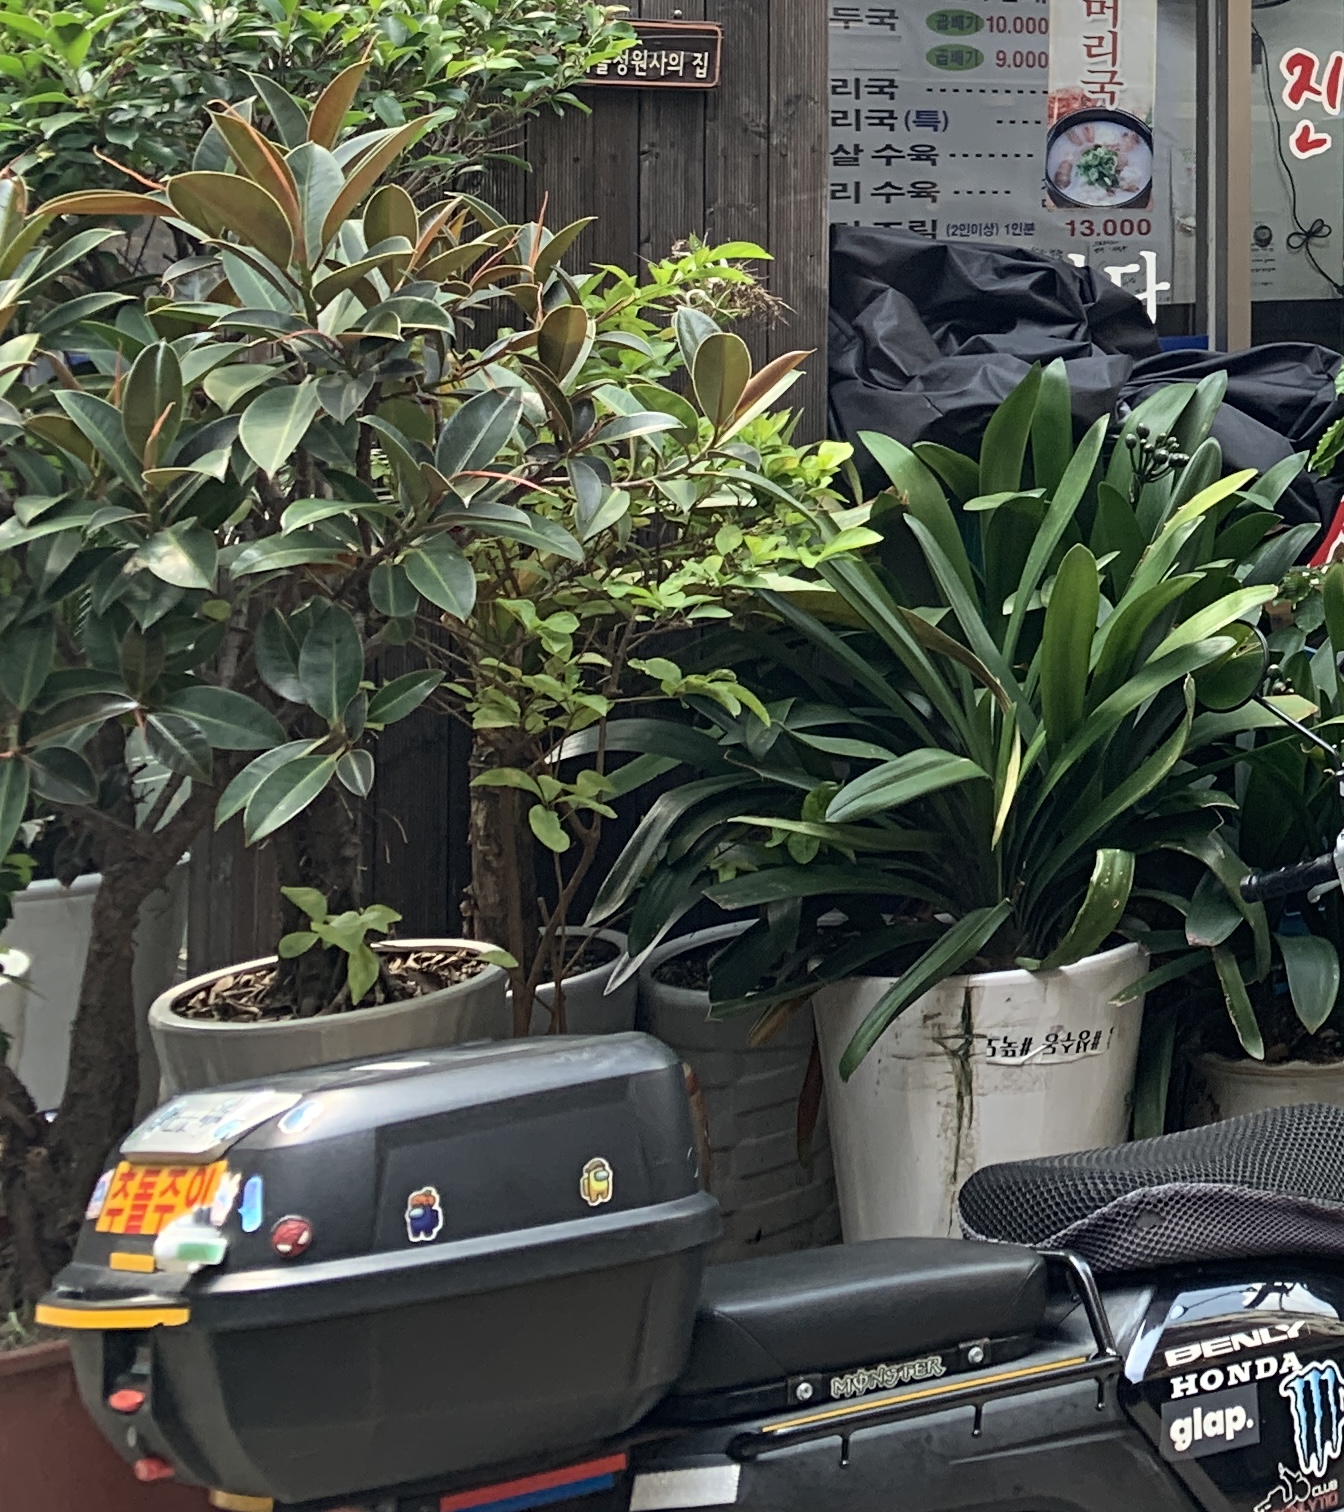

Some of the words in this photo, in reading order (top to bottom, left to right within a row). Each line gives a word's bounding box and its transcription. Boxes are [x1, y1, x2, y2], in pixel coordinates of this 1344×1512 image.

[586, 49, 685, 77] 을정원사의
[691, 51, 709, 78] 집
[1065, 218, 1152, 237] 13.000
[1164, 1320, 1306, 1368] BENLY
[830, 1355, 947, 1399] MONSTER
[1170, 1350, 1303, 1399] HONDA
[1169, 1404, 1255, 1452] glap.
